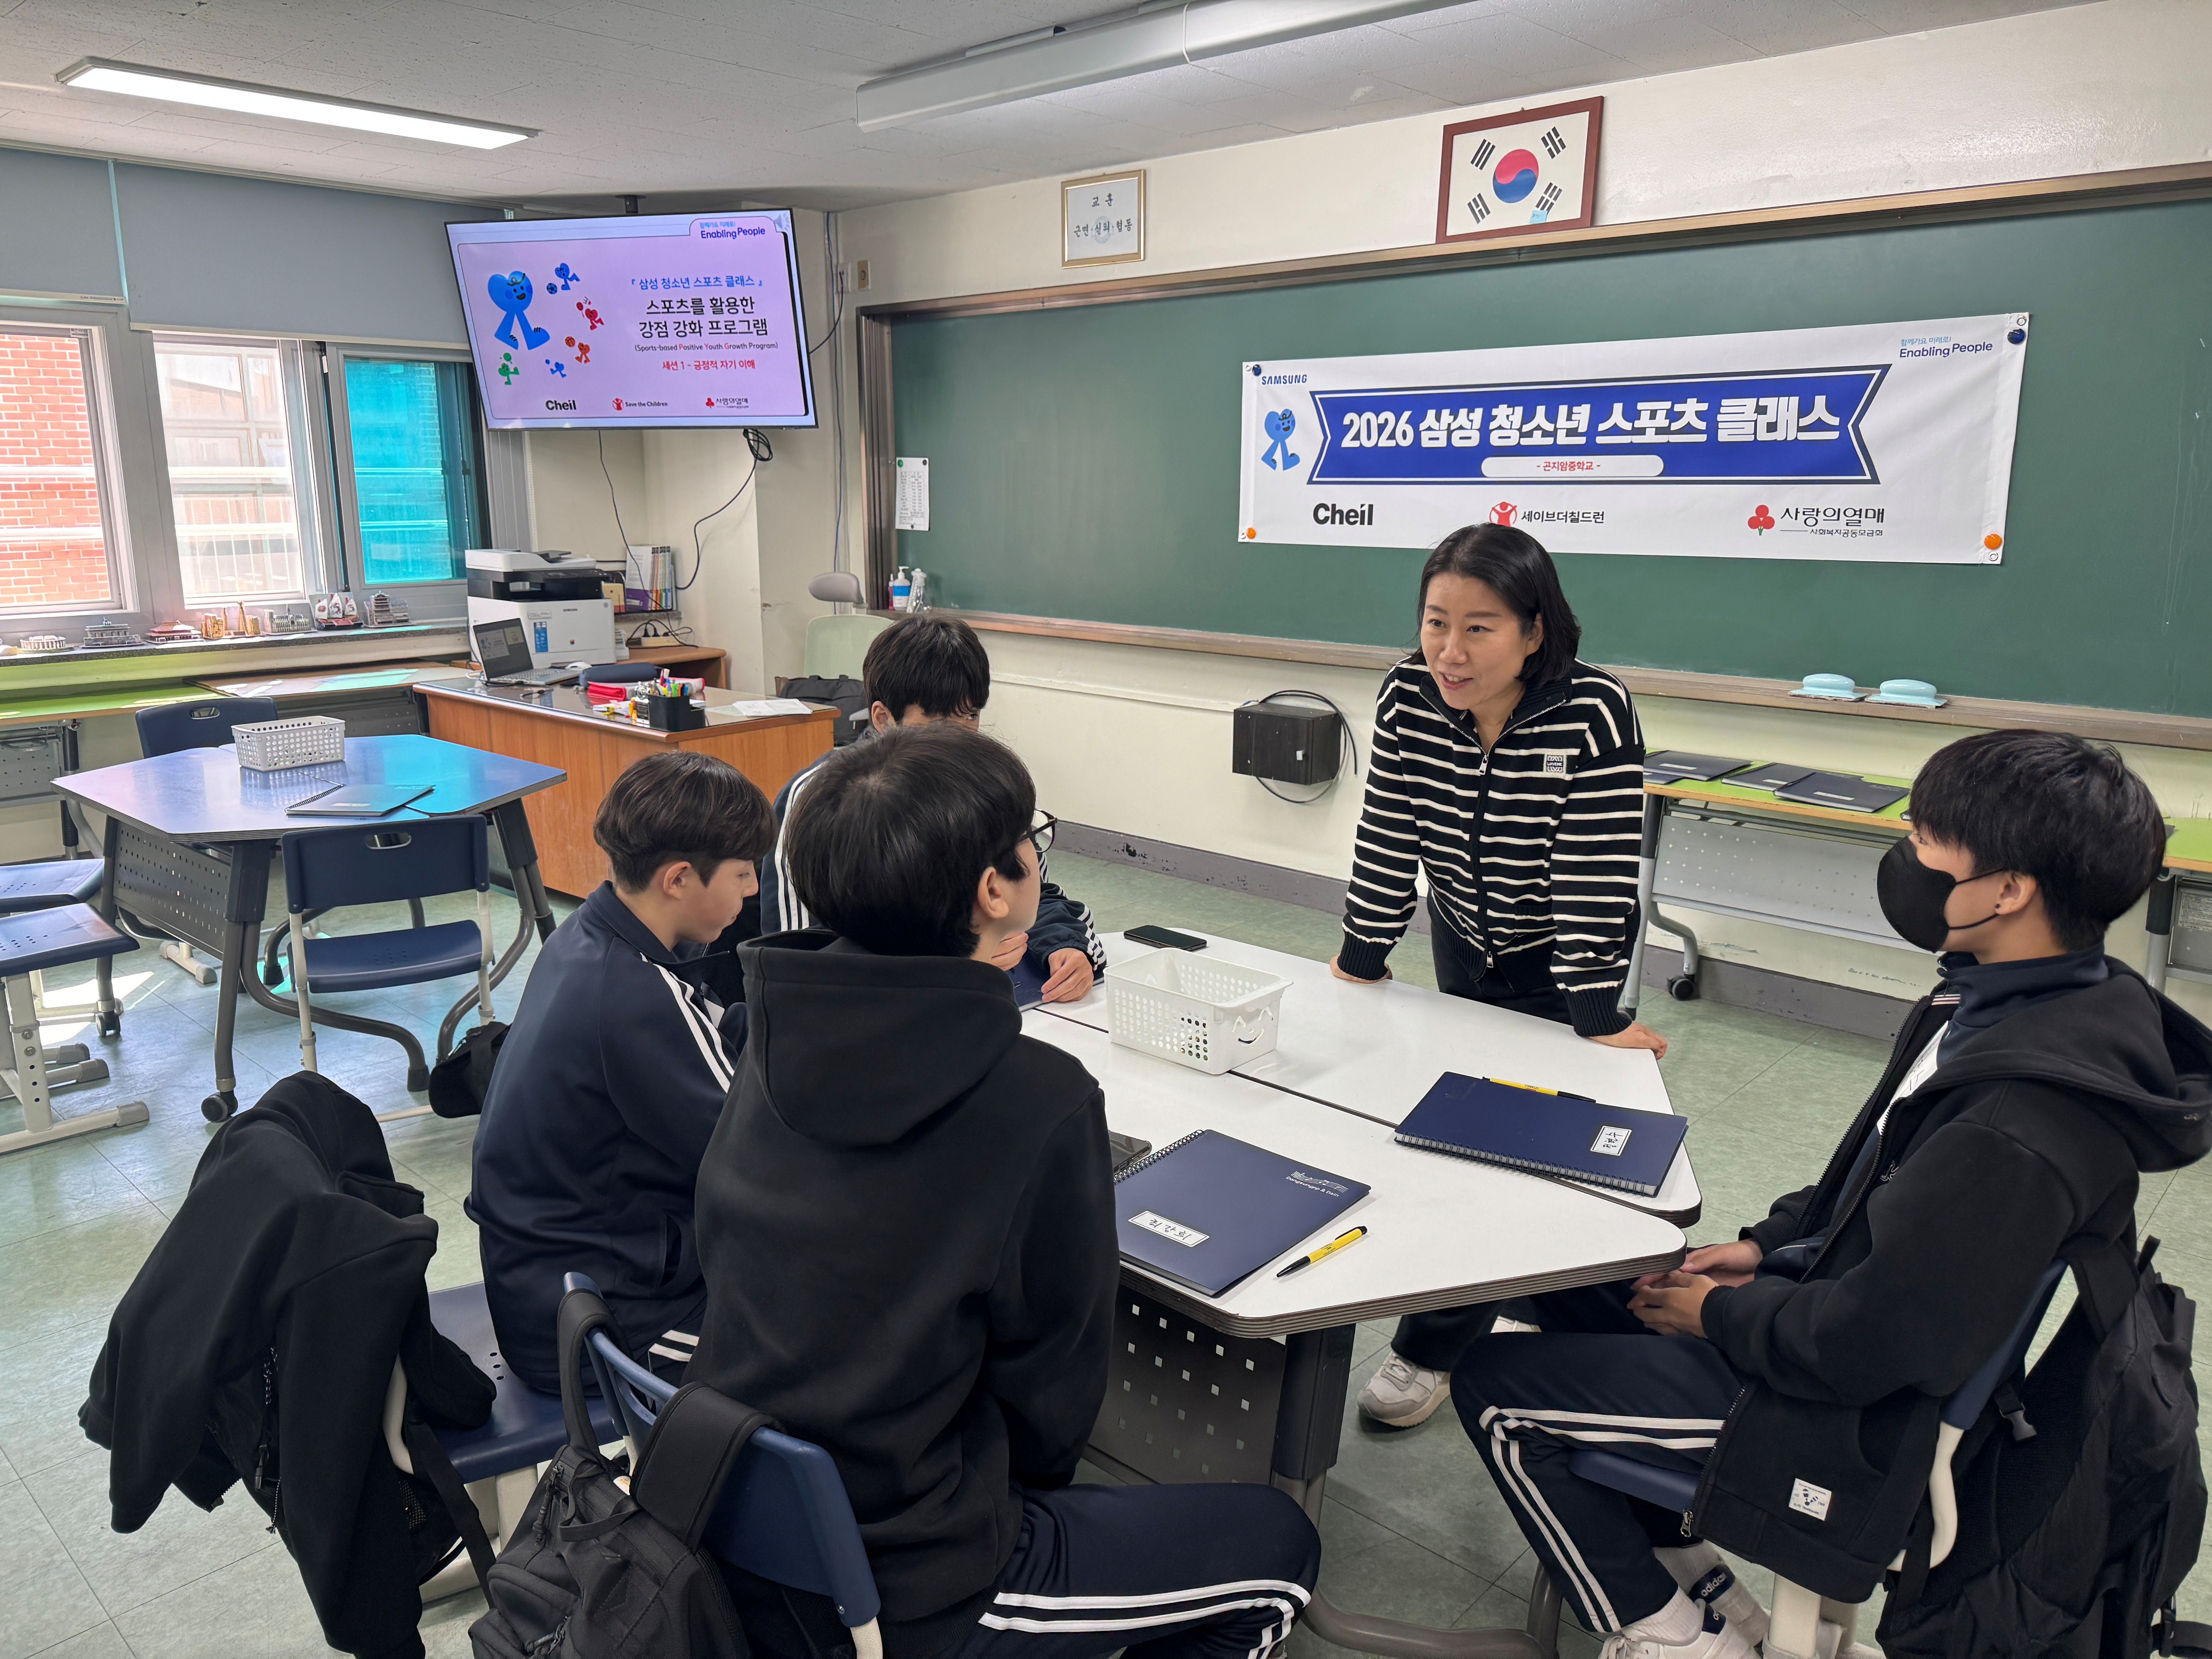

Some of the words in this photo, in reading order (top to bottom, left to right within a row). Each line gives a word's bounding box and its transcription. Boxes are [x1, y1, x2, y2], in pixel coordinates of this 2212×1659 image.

[701, 230, 737, 239] Enabling
[737, 227, 765, 237] People
[639, 278, 658, 290] 삼성
[661, 277, 690, 289] 청소년
[694, 276, 723, 287] 스포츠
[725, 275, 755, 287] 클래스
[646, 298, 705, 315] 스포츠를
[710, 296, 755, 315] 활용한
[639, 320, 669, 338] 강점
[673, 319, 703, 337] 강화
[708, 318, 768, 336] 프로그램
[635, 344, 678, 352] (Sports-based
[749, 342, 778, 351] Program)
[1900, 338, 1927, 347] 함께가요
[1899, 346, 1950, 358] Enabling
[1952, 342, 1993, 354] People
[663, 361, 678, 371] 세션
[681, 361, 684, 370] 1
[694, 360, 718, 370] 긍정적
[720, 360, 736, 370] 자기
[739, 359, 755, 369] 이해
[1262, 374, 1307, 385] SAMSUNG
[546, 400, 577, 410] Cheil
[1341, 410, 1414, 448] 2026
[1419, 407, 1484, 448] 삼성
[1489, 404, 1590, 446] 청소년
[1595, 398, 1708, 444] 스포츠
[1717, 395, 1840, 441] 클래스
[1543, 460, 1593, 472] 곤지암중학교
[1313, 503, 1373, 526] Cheil
[1521, 510, 1604, 524] 세이브더칠드런
[1781, 508, 1884, 527] 사랑의열매
[1810, 529, 1882, 538] 사회복지공동모금회
